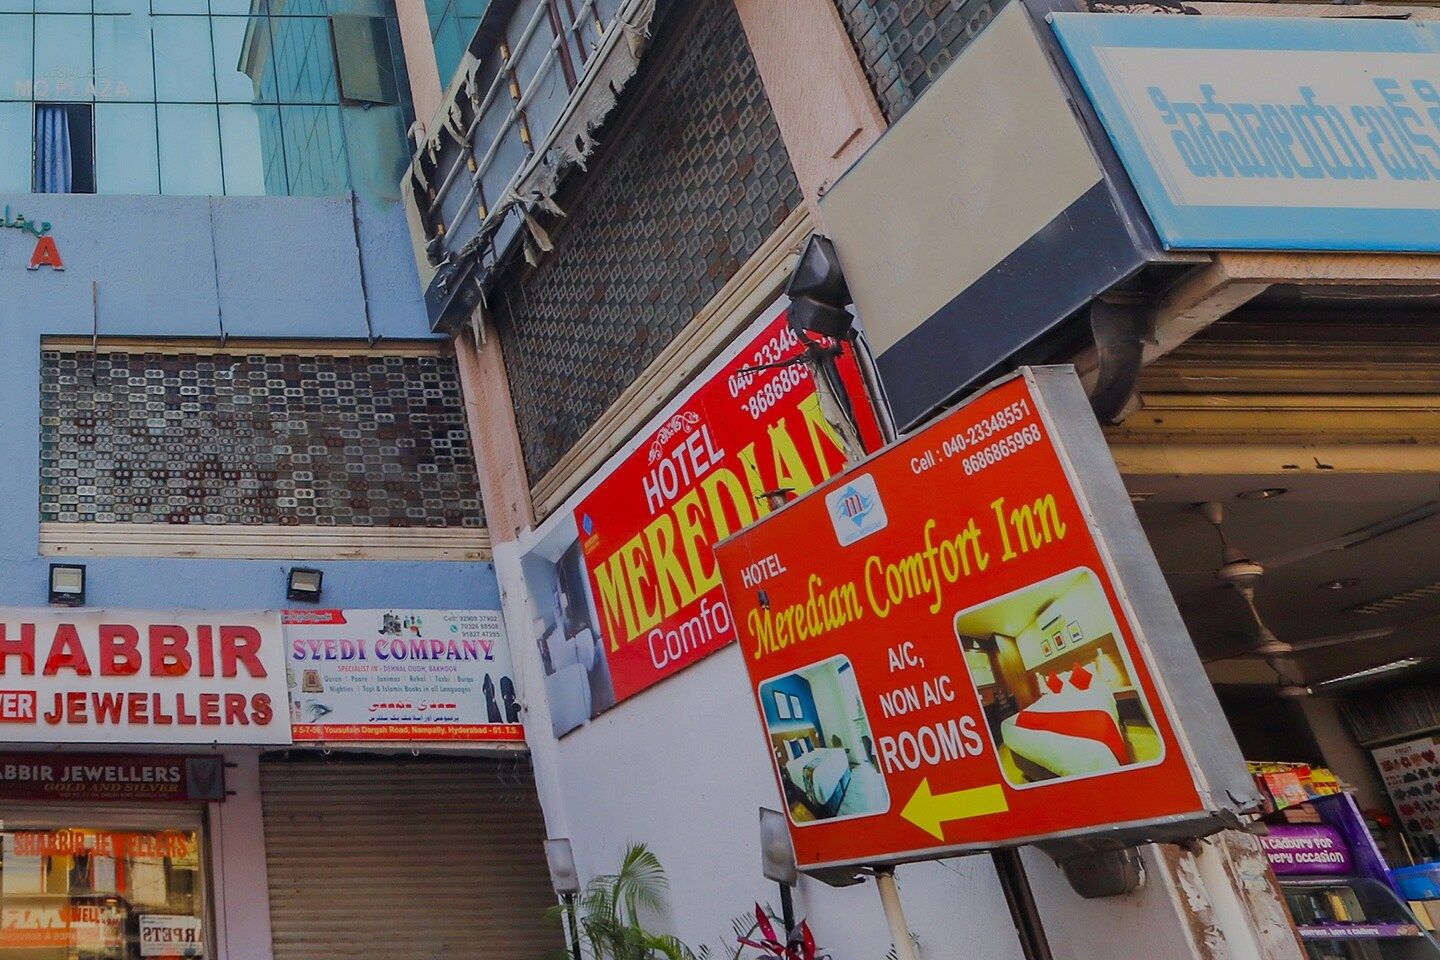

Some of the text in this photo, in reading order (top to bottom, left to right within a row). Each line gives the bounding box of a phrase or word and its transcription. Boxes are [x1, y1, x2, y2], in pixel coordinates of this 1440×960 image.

[911, 451, 936, 476] Cell
[943, 398, 1031, 461] 040-23348551
[961, 423, 1042, 476] 8686865968
[642, 423, 724, 514] HOTEL
[740, 553, 787, 590] HOTEL
[748, 492, 1067, 660] Meredian Comfort Inn
[292, 639, 495, 662] SYEDI COMPANY
[648, 598, 730, 670] Comfo
[887, 640, 926, 674] A/C,
[43, 691, 275, 726] JEWELLERS
[879, 674, 955, 719] NON A/C
[361, 726, 388, 735] Dargah
[448, 727, 487, 735] Hyderabad
[880, 715, 985, 774] ROOMS
[44, 783, 179, 792] GOLD AND SILVER
[61, 765, 181, 782] JEWELLERS
[1267, 850, 1345, 864] very occasion
[1269, 837, 1313, 850] cadbury
[1313, 837, 1333, 849] for
